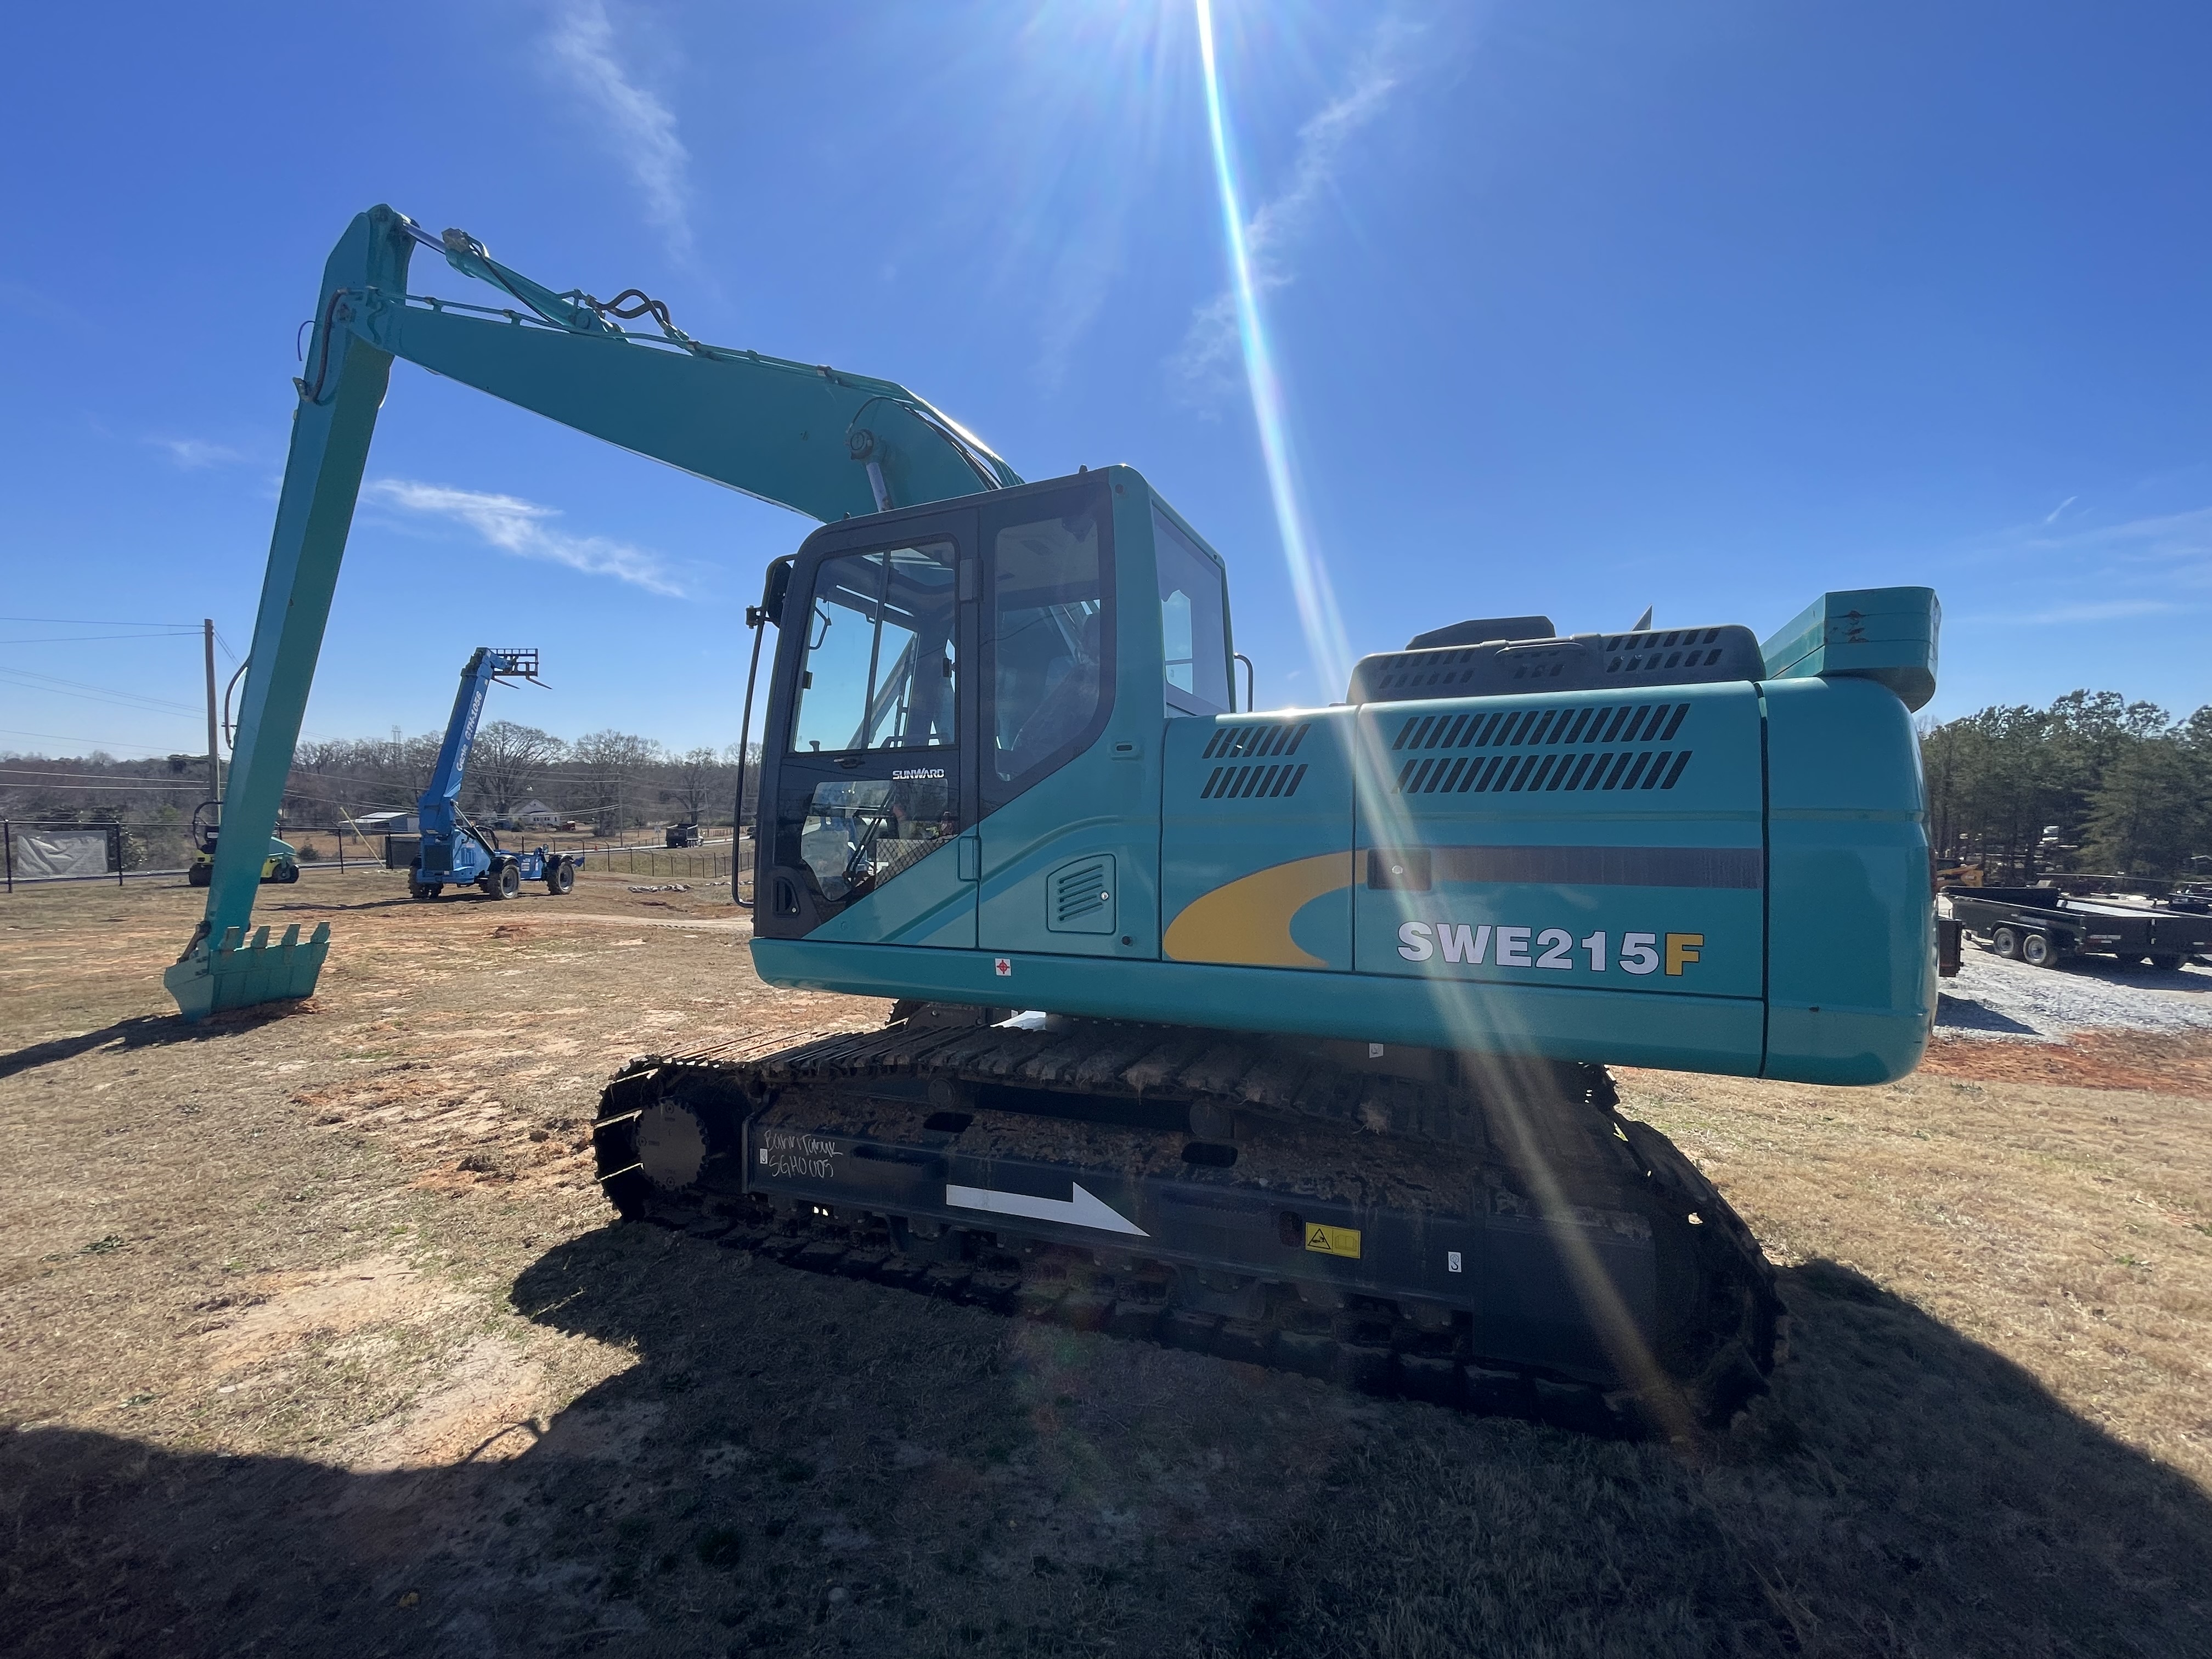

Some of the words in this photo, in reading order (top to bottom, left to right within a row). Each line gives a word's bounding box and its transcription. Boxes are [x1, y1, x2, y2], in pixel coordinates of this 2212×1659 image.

[456, 744, 468, 771] Genie
[465, 691, 482, 740] GTH-1056
[892, 768, 944, 779] SUNWARD
[1397, 921, 1704, 975] SWE215F
